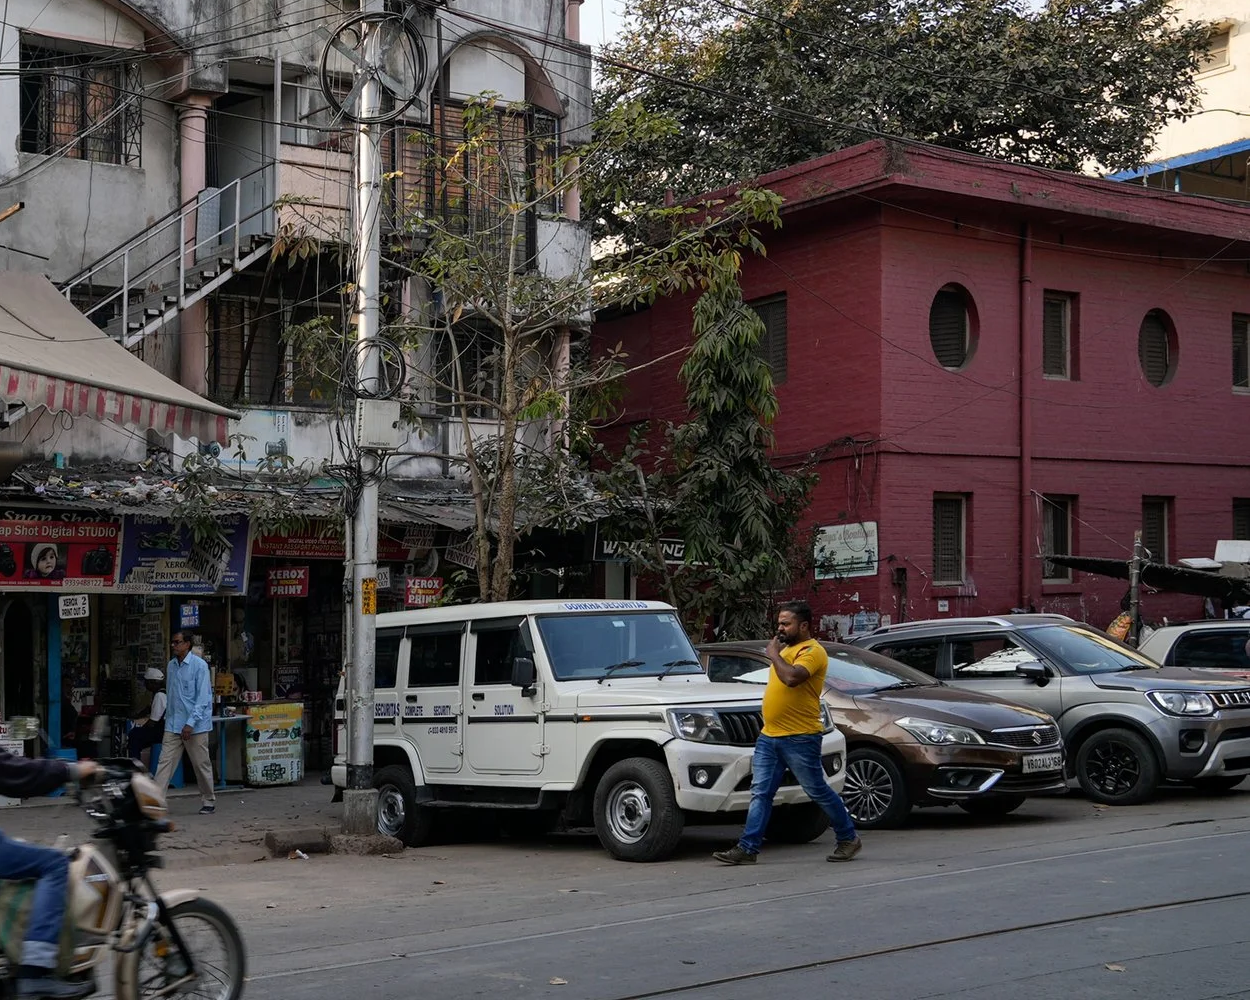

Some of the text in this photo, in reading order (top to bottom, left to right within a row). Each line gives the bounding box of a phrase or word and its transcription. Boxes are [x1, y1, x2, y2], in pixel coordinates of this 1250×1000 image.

[14, 525, 39, 536] Shot
[42, 526, 75, 538] Digital
[78, 527, 116, 538] STUDIO
[187, 550, 208, 578] PRINT
[155, 571, 197, 580] PRINT OUT
[268, 569, 305, 580] XEROX
[407, 579, 440, 588] XEROX
[270, 585, 302, 595] PRINT
[82, 596, 86, 605] 2
[408, 594, 438, 604] PRINT
[82, 606, 86, 615] 5
[375, 702, 400, 716] SECURITAS
[404, 704, 514, 716] COMPLETE SECURITY SOLUTION
